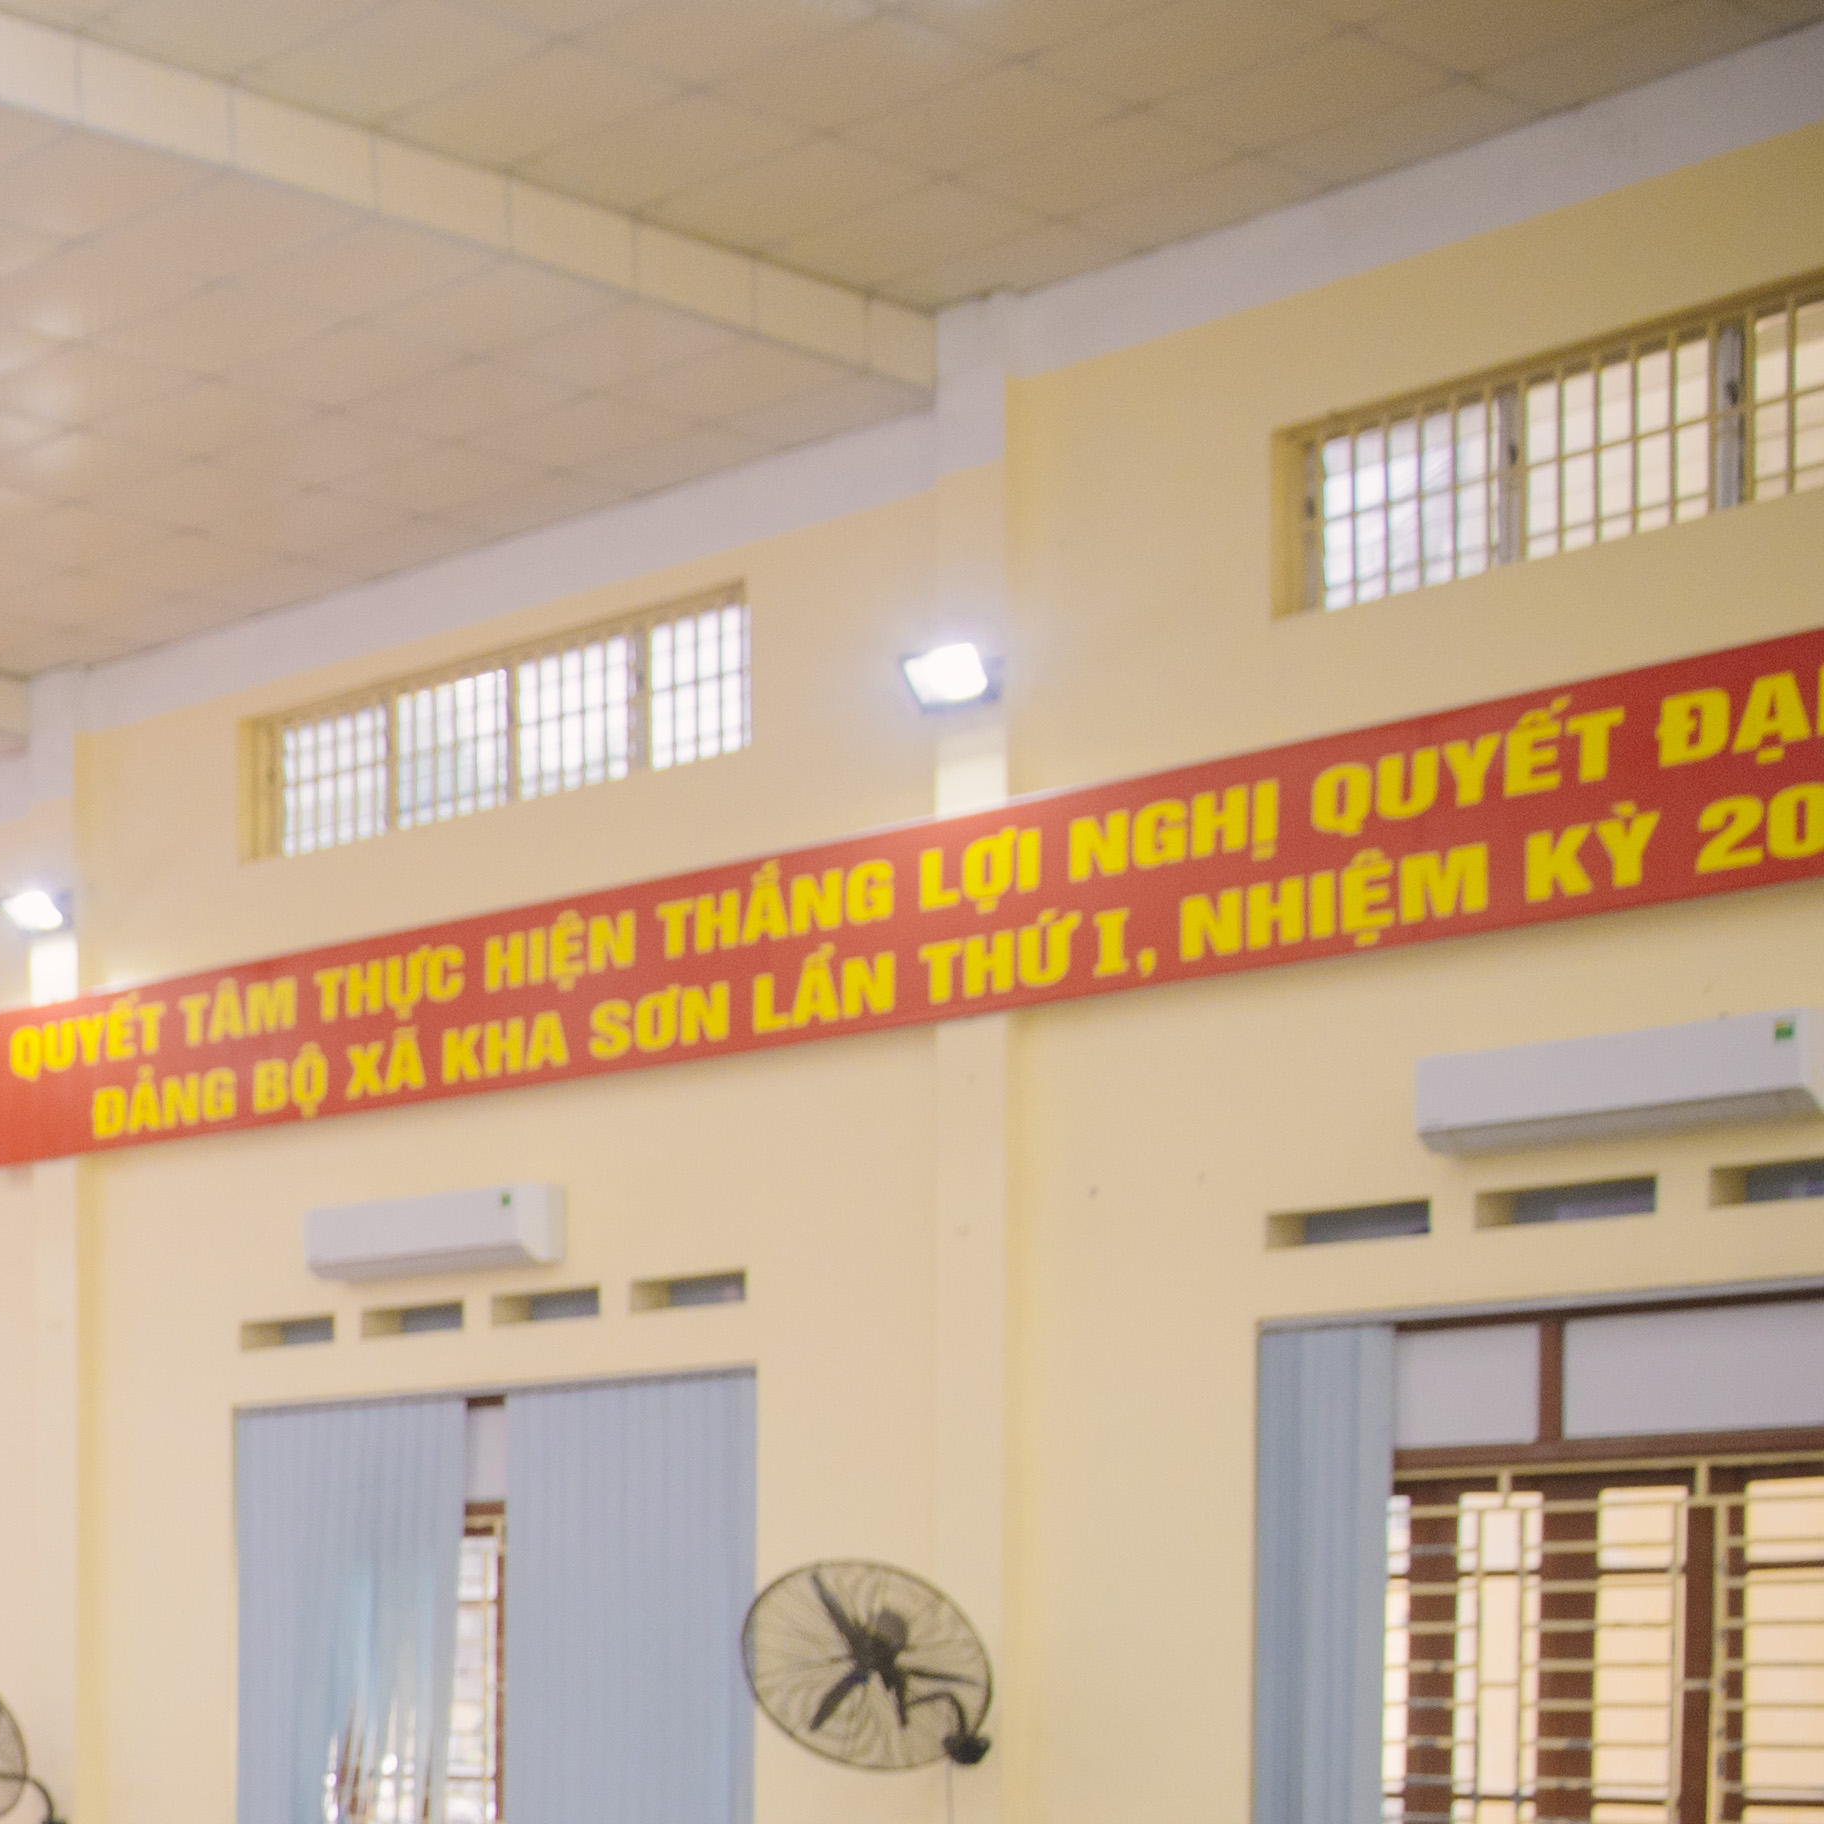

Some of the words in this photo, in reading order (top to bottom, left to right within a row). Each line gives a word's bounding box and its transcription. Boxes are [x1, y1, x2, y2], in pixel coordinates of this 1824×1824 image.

[10, 985, 164, 1080] QUYẾT
[180, 964, 297, 1044] TÂM
[316, 942, 464, 1020] THỰC
[485, 911, 636, 991] HIỆN
[656, 860, 895, 960] THẮNG
[919, 822, 1041, 913] LỢI
[1069, 778, 1281, 861] NGHỊ
[1311, 695, 1626, 837] QUYẾT
[1656, 664, 1824, 767] ĐẠ
[92, 1064, 237, 1140] ĐẢNG
[253, 1042, 329, 1119] BỘ
[346, 1026, 427, 1100] XÃ
[442, 1010, 570, 1083] KHA
[588, 978, 732, 1060] SƠN
[919, 905, 1081, 1003] THỨ
[1180, 846, 1490, 962] NHIỆM
[1525, 801, 1661, 903] KỲ
